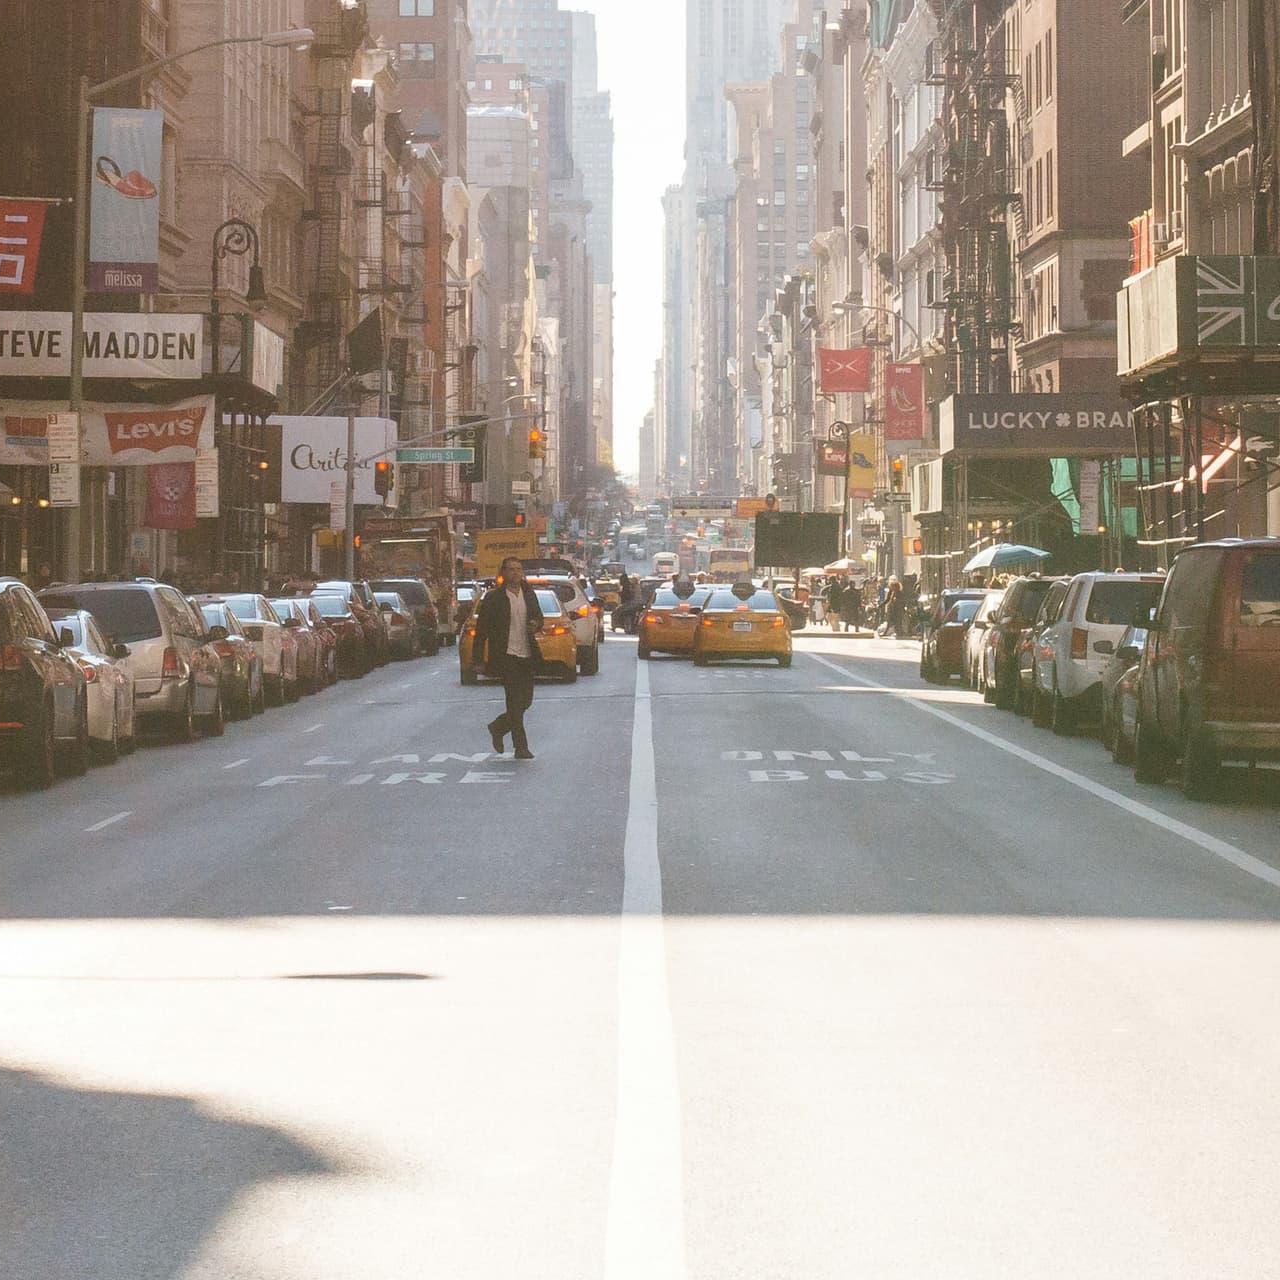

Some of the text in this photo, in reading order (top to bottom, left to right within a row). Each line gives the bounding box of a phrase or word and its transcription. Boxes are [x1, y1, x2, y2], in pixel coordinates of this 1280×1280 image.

[82, 332, 196, 361] MADDEN
[969, 411, 1052, 429] LUCKY
[415, 450, 454, 461] Spring St
[721, 750, 938, 765] ONLY
[256, 769, 956, 786] FIRE BUS
